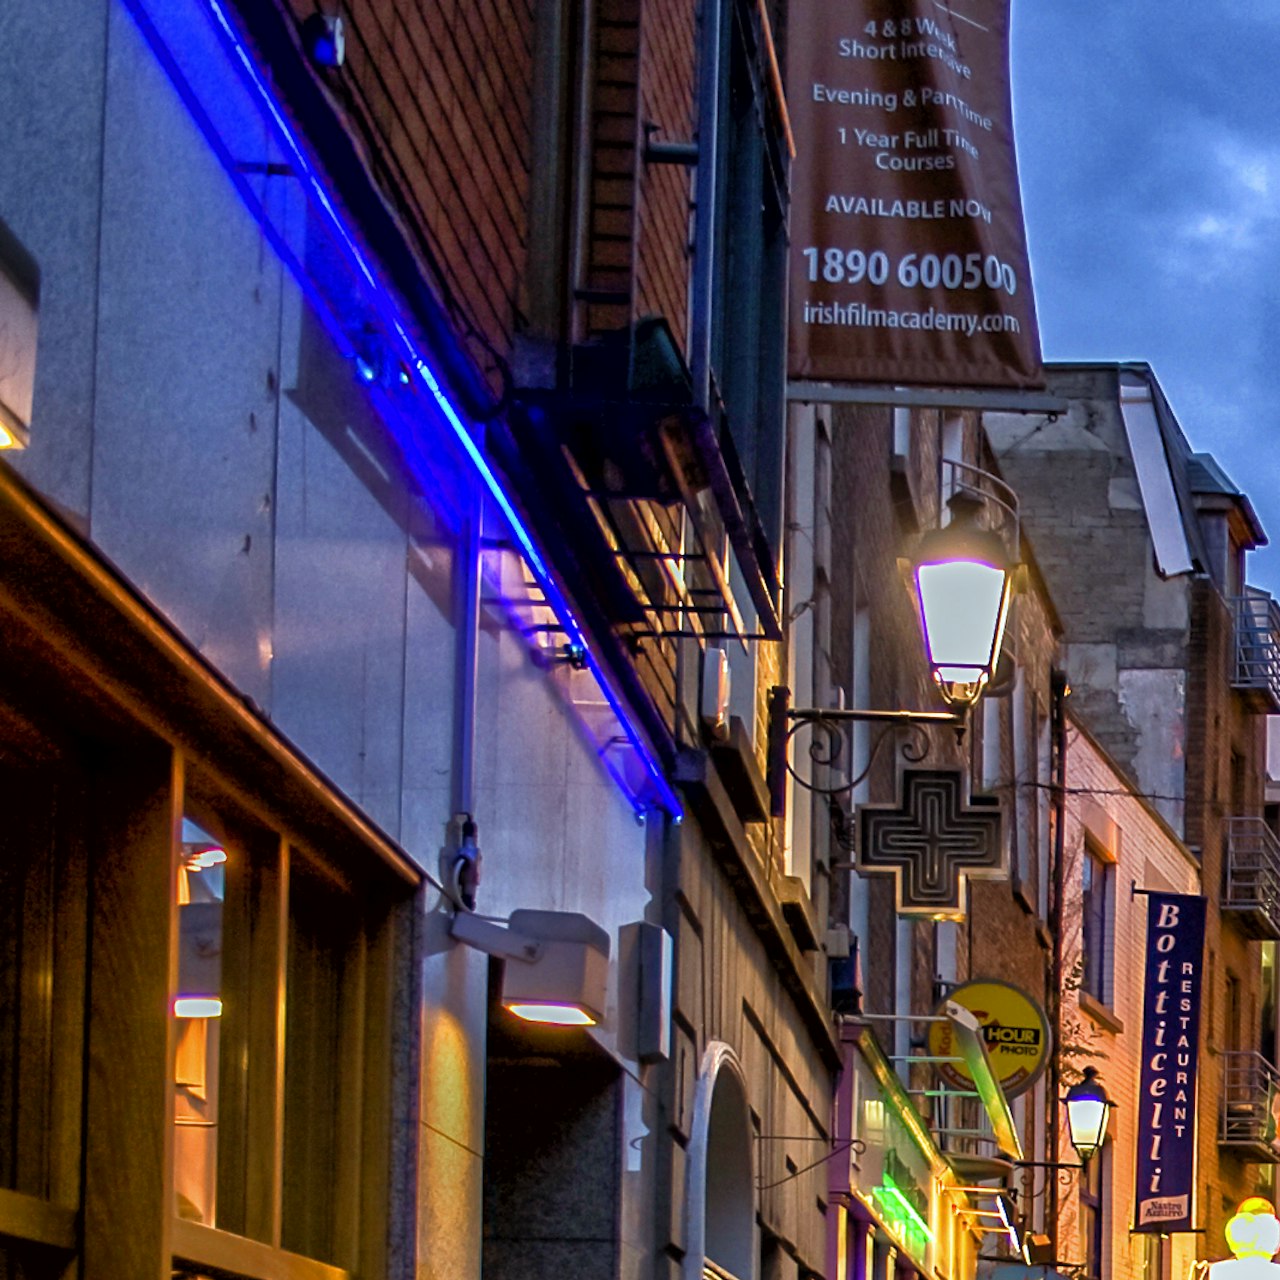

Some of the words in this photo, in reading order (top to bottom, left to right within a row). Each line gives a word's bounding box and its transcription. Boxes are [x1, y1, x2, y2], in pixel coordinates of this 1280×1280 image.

[864, 20, 877, 38] 4
[882, 20, 898, 38] &
[900, 18, 911, 36] 8
[838, 39, 897, 60] Short
[813, 83, 898, 112] Evening
[902, 89, 917, 107] &
[838, 128, 847, 145] 1
[854, 128, 899, 148] Year
[904, 131, 939, 149] Full
[942, 129, 979, 160] Time
[875, 152, 955, 171] Courses
[825, 195, 945, 219] AVAILABLE
[949, 200, 992, 224] NOW
[803, 247, 889, 286] 1890
[897, 253, 1017, 295] 600500
[803, 300, 1021, 338] irishfilmacademy.com
[987, 1028, 1035, 1043] HOUR
[1148, 903, 1181, 1194] Botticelli
[1173, 961, 1194, 1138] RESTAURANT
[1000, 1045, 1039, 1056] PHOTO
